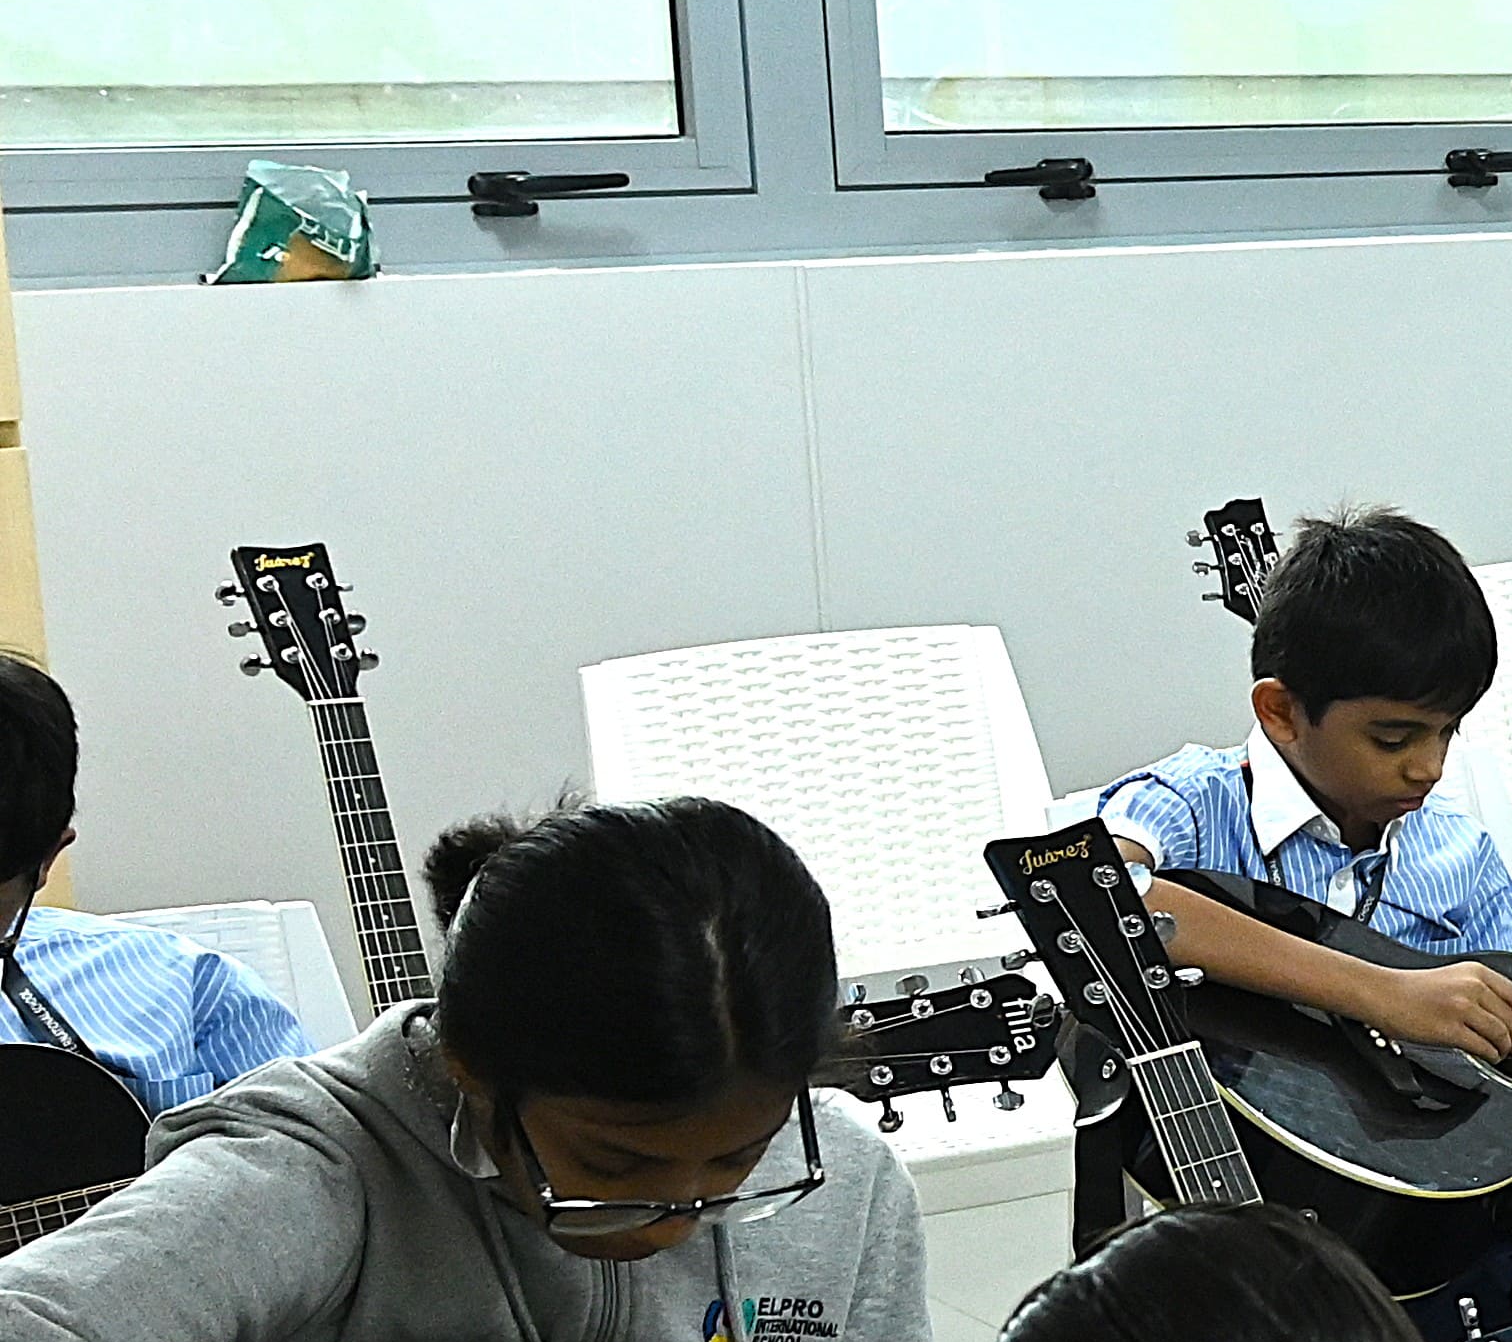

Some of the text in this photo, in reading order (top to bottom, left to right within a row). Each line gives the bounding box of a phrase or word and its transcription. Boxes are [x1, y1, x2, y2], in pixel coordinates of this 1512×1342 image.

[1357, 895, 1376, 922] CHOOL
[1002, 997, 1036, 1054] filia
[757, 1297, 824, 1319] ELPRO
[754, 1318, 838, 1338] INTERNATIONAL
